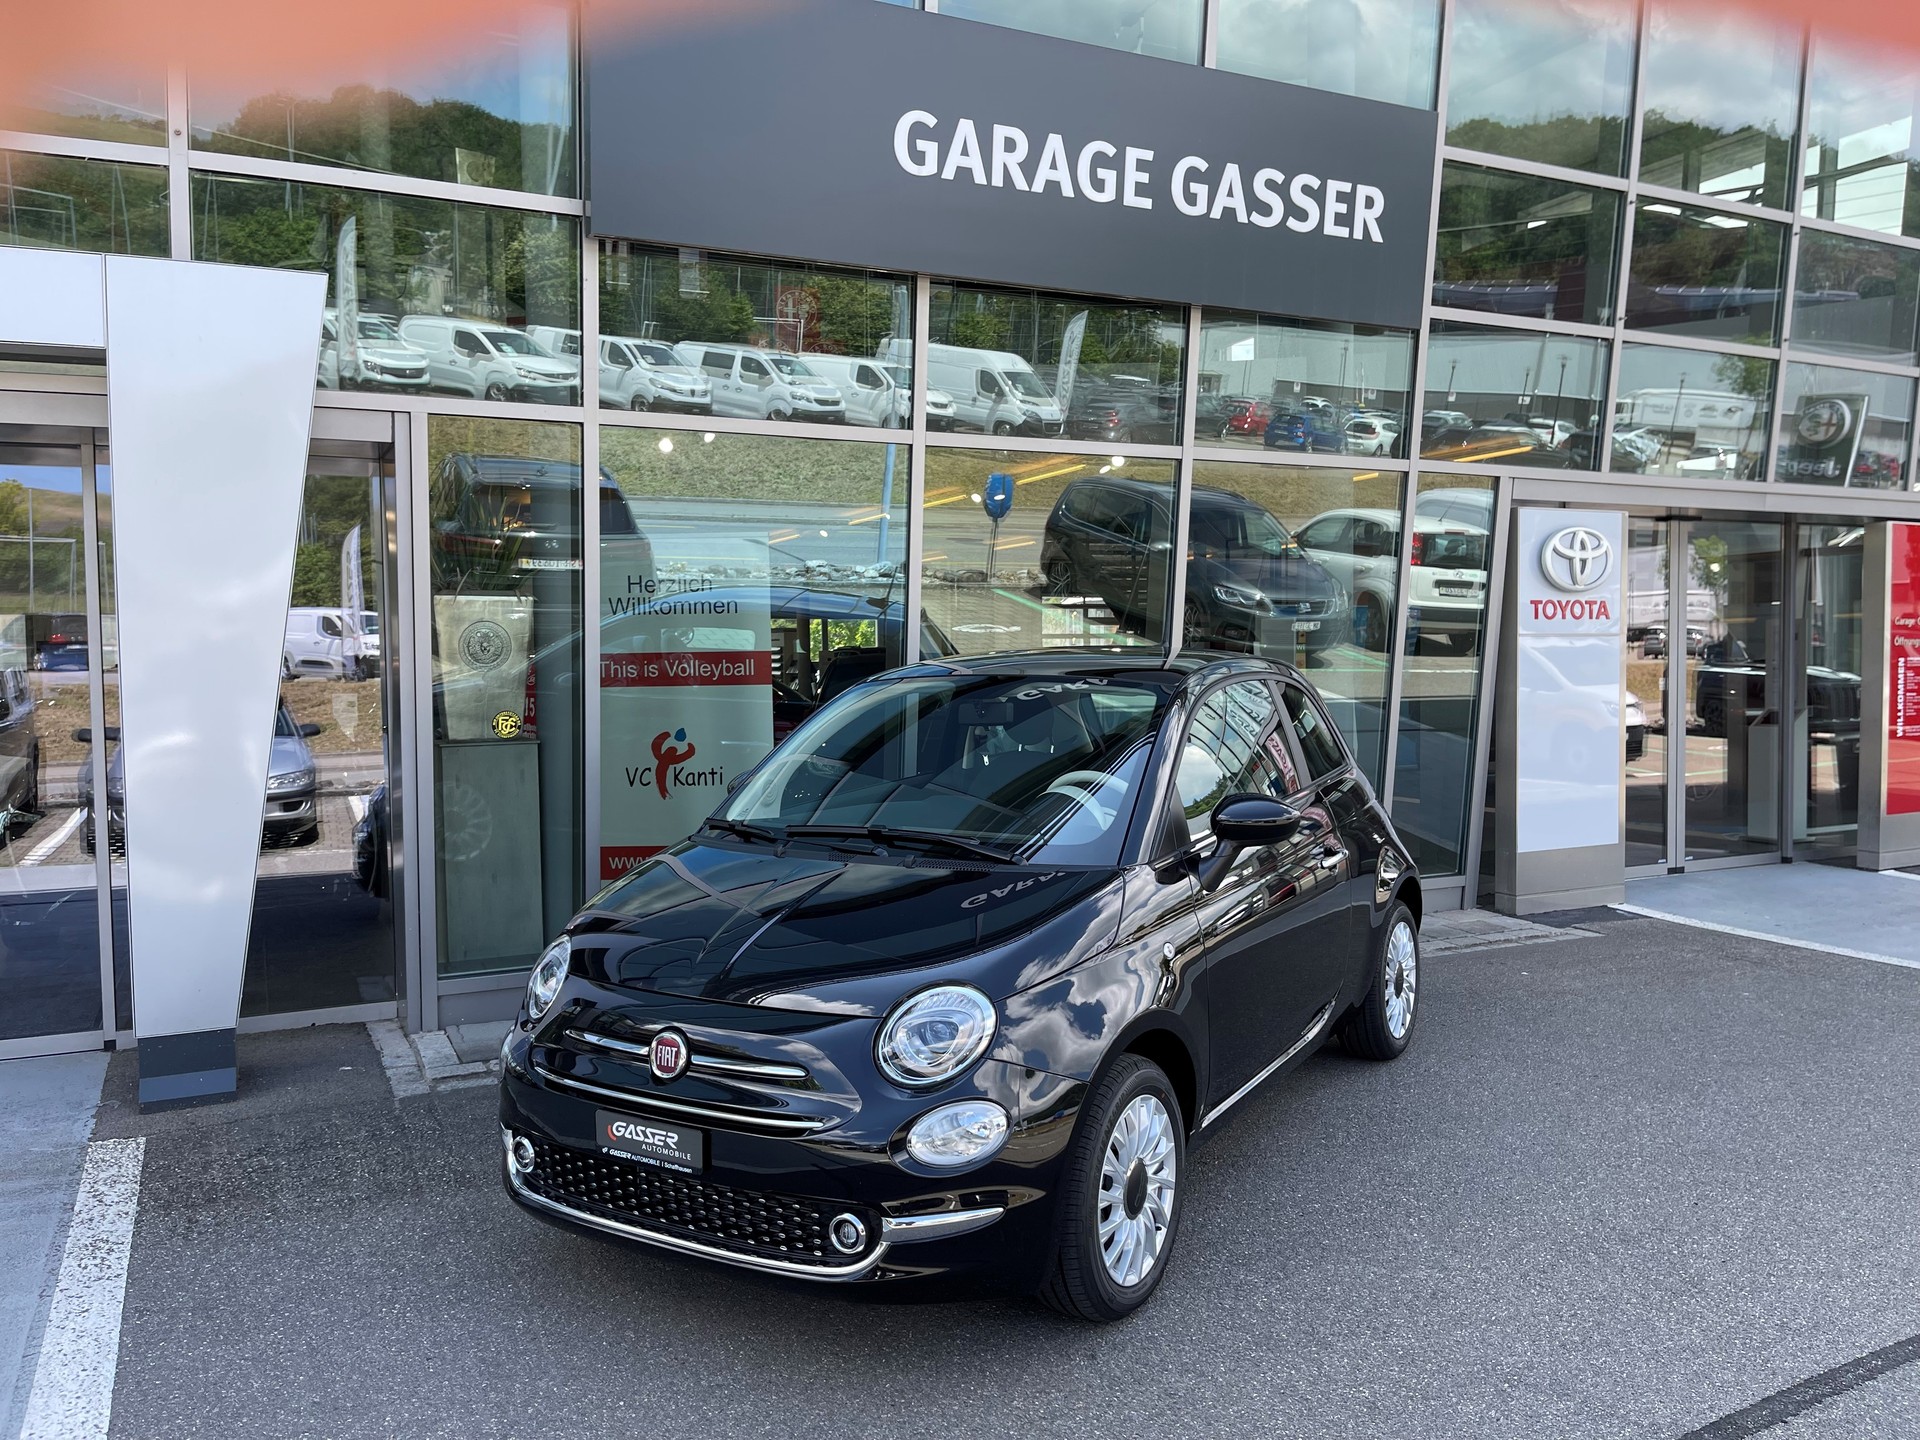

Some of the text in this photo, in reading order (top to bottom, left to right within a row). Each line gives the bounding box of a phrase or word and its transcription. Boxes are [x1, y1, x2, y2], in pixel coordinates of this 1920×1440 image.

[893, 110, 1385, 243] GARAGE GASSER
[627, 575, 713, 594] Herzlich
[608, 597, 738, 616] Willkommen
[1530, 599, 1610, 620] TOYOTA
[600, 659, 755, 681] This is Volleyball
[1896, 657, 1905, 737] WILLKOMMEN
[625, 766, 723, 788] VC Kanti
[657, 1045, 678, 1067] FIAT
[611, 1121, 679, 1150] GASSER
[609, 1148, 632, 1160] GASSER
[631, 1154, 661, 1167] AUTOMOBILE
[641, 1143, 692, 1161] AUTOMOBILE
